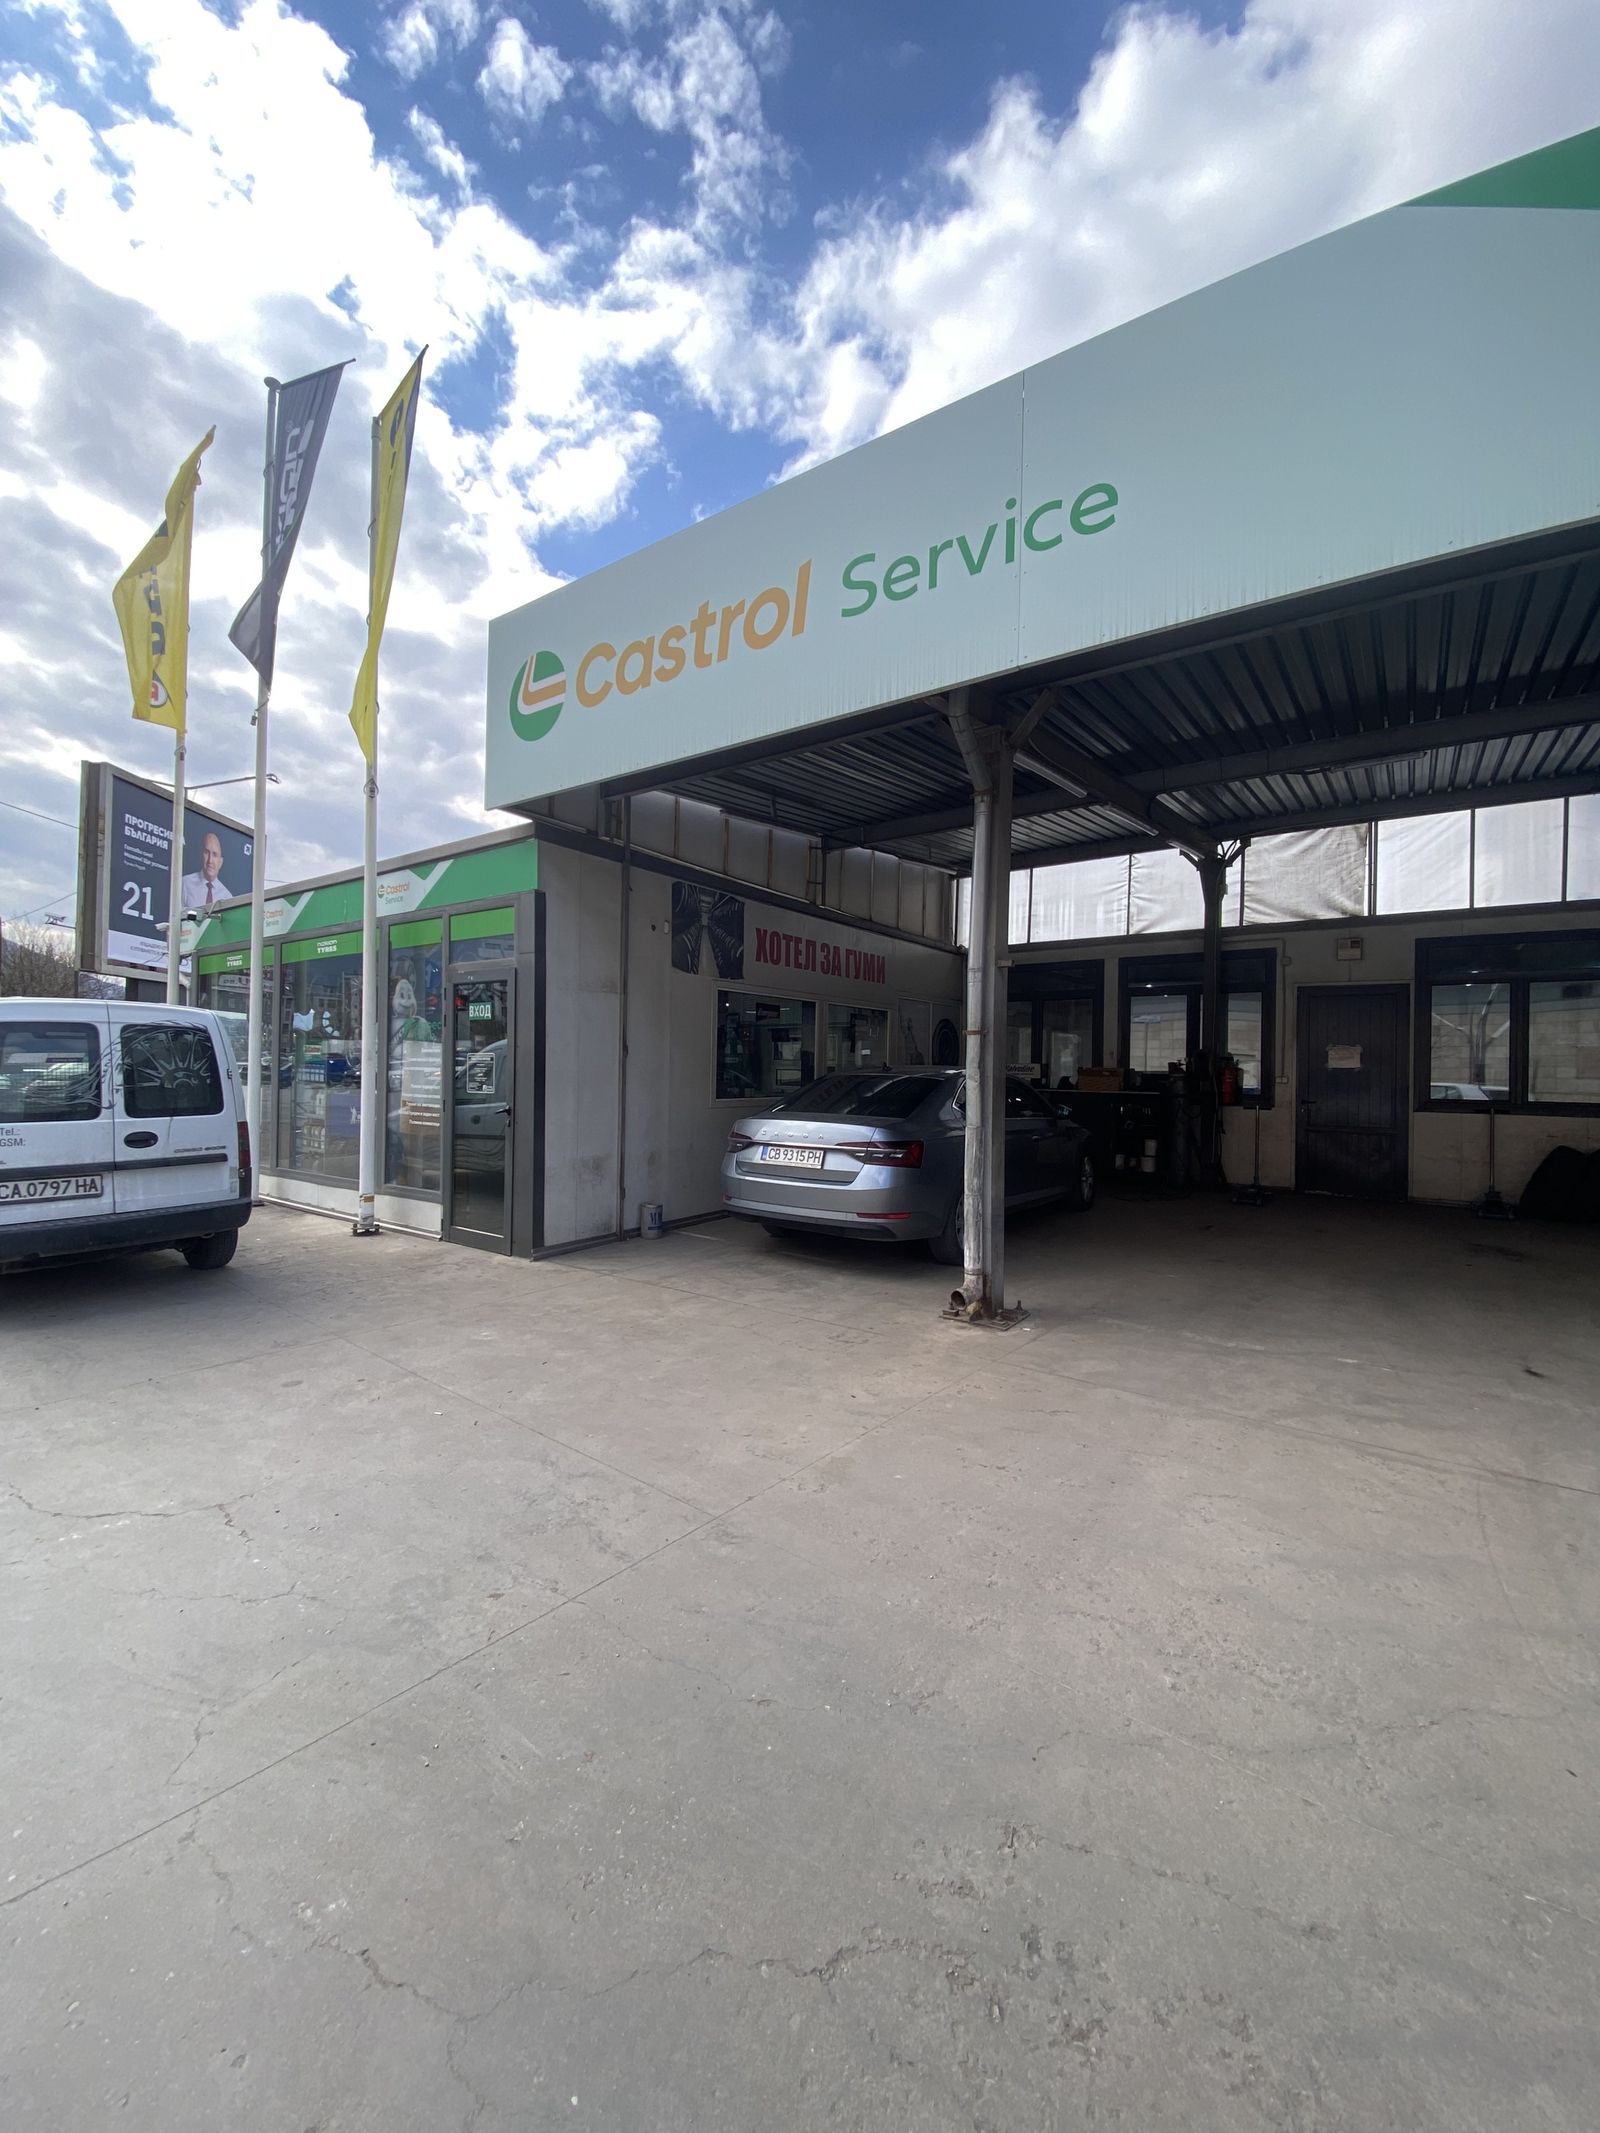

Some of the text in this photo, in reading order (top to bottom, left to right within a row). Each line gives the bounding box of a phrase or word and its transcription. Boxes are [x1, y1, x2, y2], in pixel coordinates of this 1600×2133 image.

[575, 482, 1120, 709] Castrol Service
[124, 826, 169, 850] БЪЛГАРИЯ
[385, 881, 410, 895] Castrol
[122, 881, 154, 921] 21
[385, 895, 404, 905] Service
[317, 944, 337, 954] TYRES
[755, 927, 886, 985] ХОТЕЛ ЗА ГУМИ
[469, 1004, 492, 1020] ВХОД
